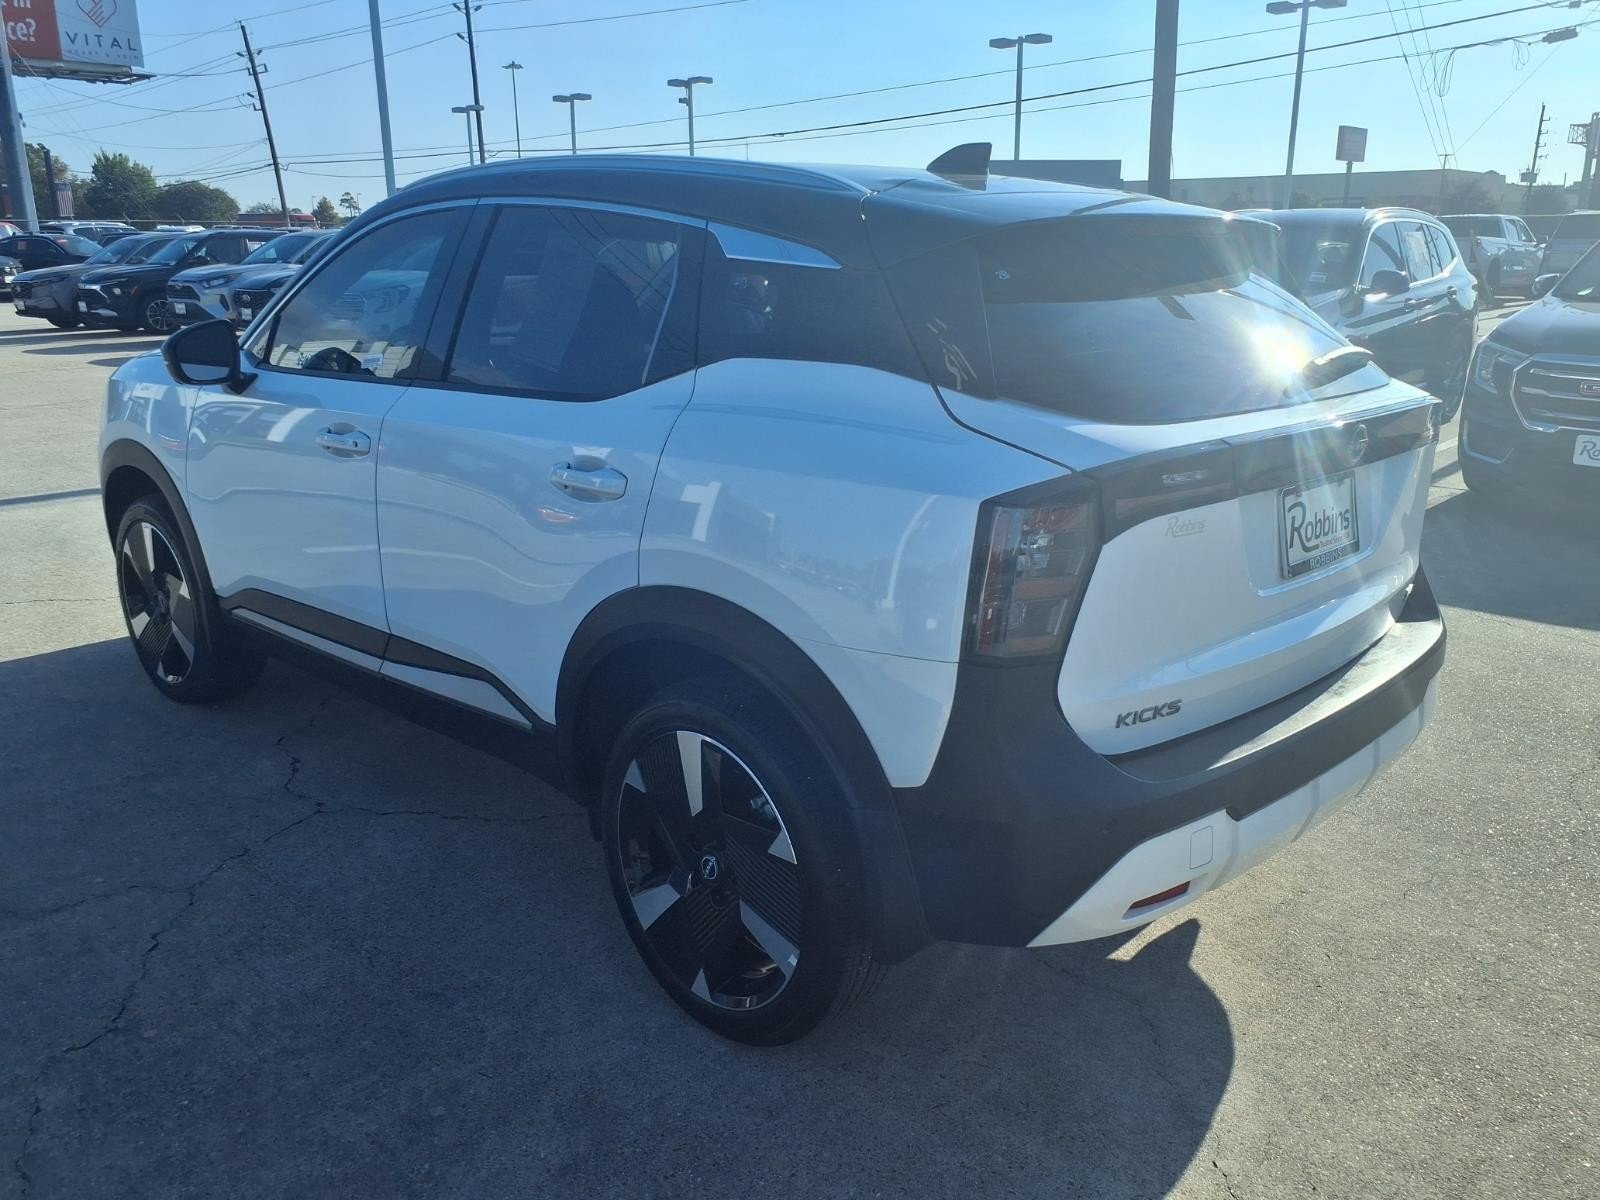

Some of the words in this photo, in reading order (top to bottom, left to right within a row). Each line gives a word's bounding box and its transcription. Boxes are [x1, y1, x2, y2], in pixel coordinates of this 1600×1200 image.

[65, 31, 137, 51] VITAL
[1287, 501, 1350, 553] Robbins
[1309, 547, 1345, 570] ROBBINS
[1115, 699, 1182, 728] KICKS
